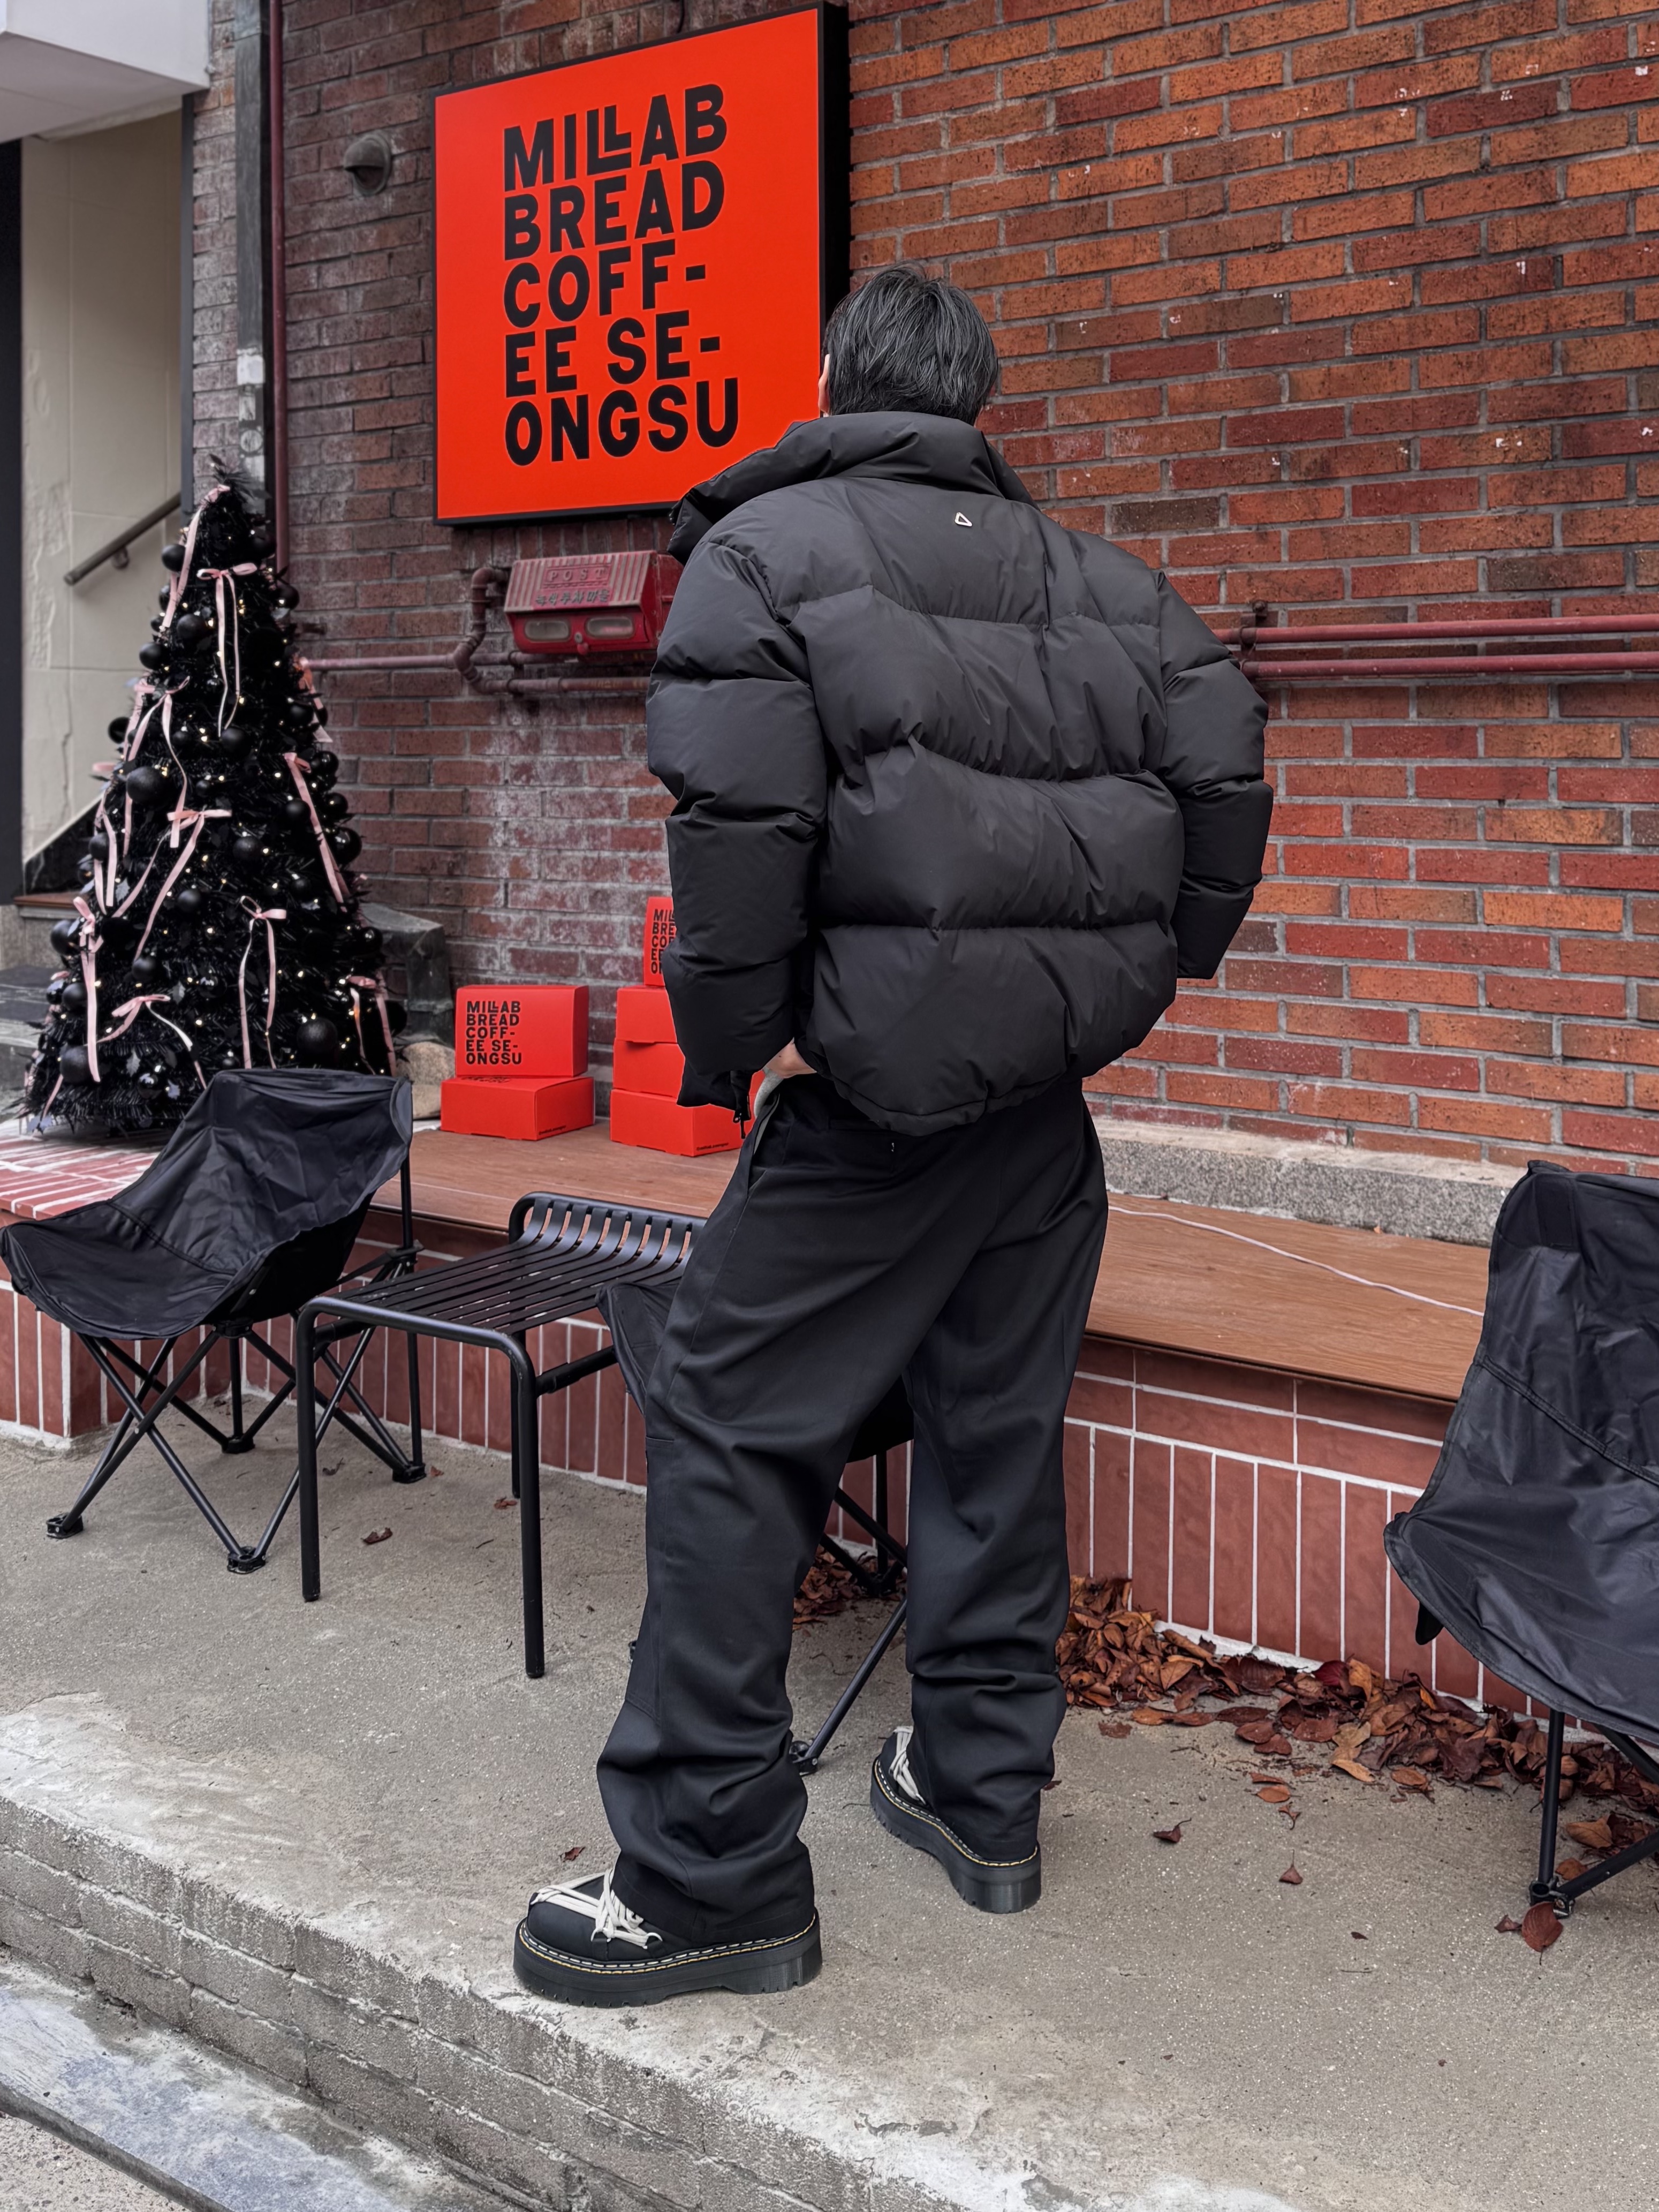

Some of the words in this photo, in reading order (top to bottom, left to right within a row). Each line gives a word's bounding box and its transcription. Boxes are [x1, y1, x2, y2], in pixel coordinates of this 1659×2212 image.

[504, 84, 727, 192] MILLAB
[504, 161, 725, 260] BREAD
[504, 239, 706, 328] COFF-
[505, 326, 578, 398] EE
[607, 310, 721, 384] SE-
[505, 378, 739, 466] ONGSU
[549, 568, 606, 582] POST
[654, 909, 675, 922] MIL
[652, 922, 676, 935] BRE
[466, 1000, 521, 1013] MILLAB
[466, 1013, 519, 1026] BREAD
[466, 1026, 515, 1039] COFF-
[466, 1039, 484, 1052] EE
[491, 1039, 518, 1052] SE-
[466, 1052, 522, 1065] ONGSU
